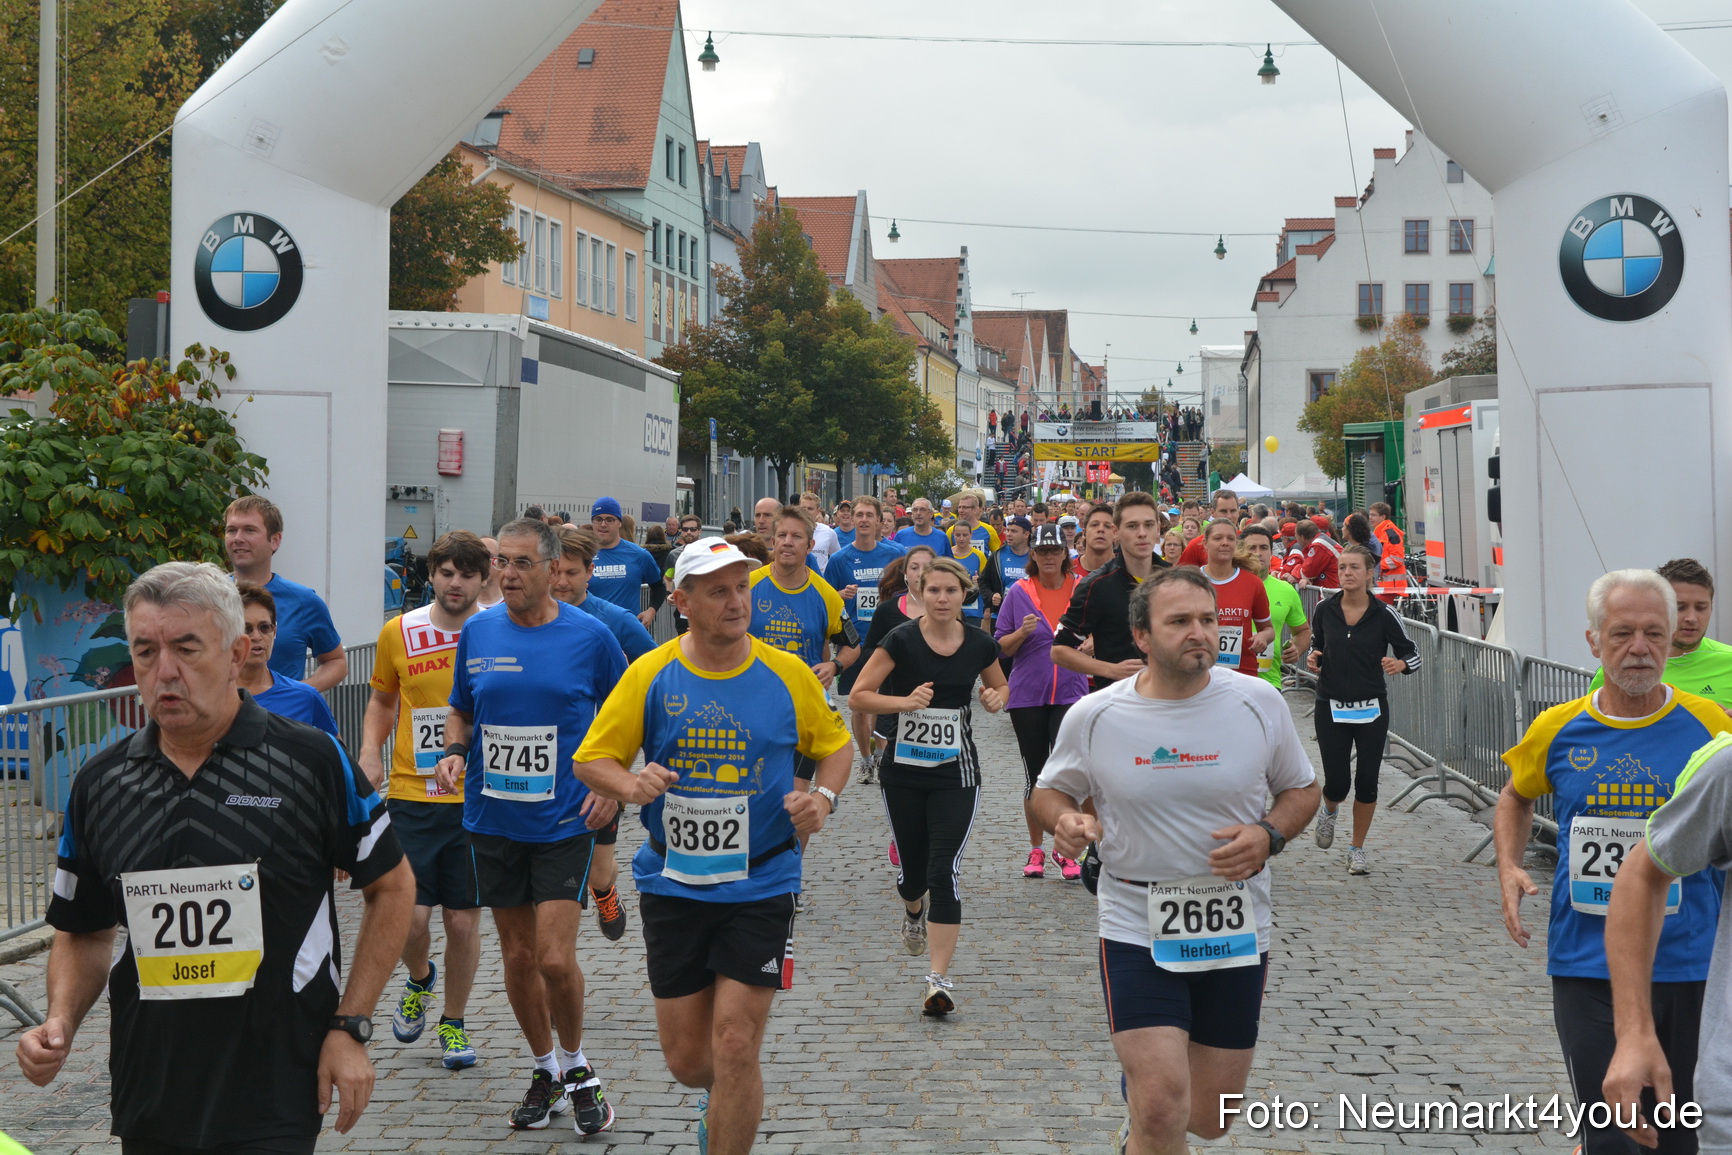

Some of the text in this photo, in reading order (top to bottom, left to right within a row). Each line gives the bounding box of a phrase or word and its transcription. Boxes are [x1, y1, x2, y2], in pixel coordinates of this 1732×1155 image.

[1569, 197, 1676, 240] BMW
[202, 215, 294, 254] BMW
[643, 412, 672, 456] BOCK
[1074, 446, 1117, 457] START
[592, 564, 626, 573] HUBER
[1218, 607, 1243, 616] ARKT
[1219, 635, 1239, 652] 67
[407, 656, 451, 677] MAX
[413, 714, 434, 722] PARTL
[900, 711, 920, 719] PARTL
[420, 723, 444, 749] 25
[504, 734, 542, 742] Neumarkt
[903, 720, 955, 746] 2299
[488, 742, 550, 773] 2745
[679, 751, 727, 760] 21.September
[910, 747, 945, 760] Melanie
[1134, 756, 1151, 766] Die
[1179, 753, 1219, 763] Meister
[504, 778, 529, 791] Ernst
[225, 794, 282, 808] DONIC
[666, 801, 732, 816] PARTL Neumarkt
[1587, 808, 1643, 818] 21.September
[668, 816, 740, 852] 3382
[1572, 826, 1608, 838] PARTL
[1581, 841, 1637, 879] 23
[126, 880, 233, 897] PARTL Neumarkt
[1151, 883, 1234, 896] PARTL Neumarkt
[1593, 887, 1612, 902] Ra
[1160, 895, 1245, 935] 2663
[151, 898, 233, 950] 202
[1180, 941, 1231, 958] Herbert
[172, 960, 215, 981] Josef
